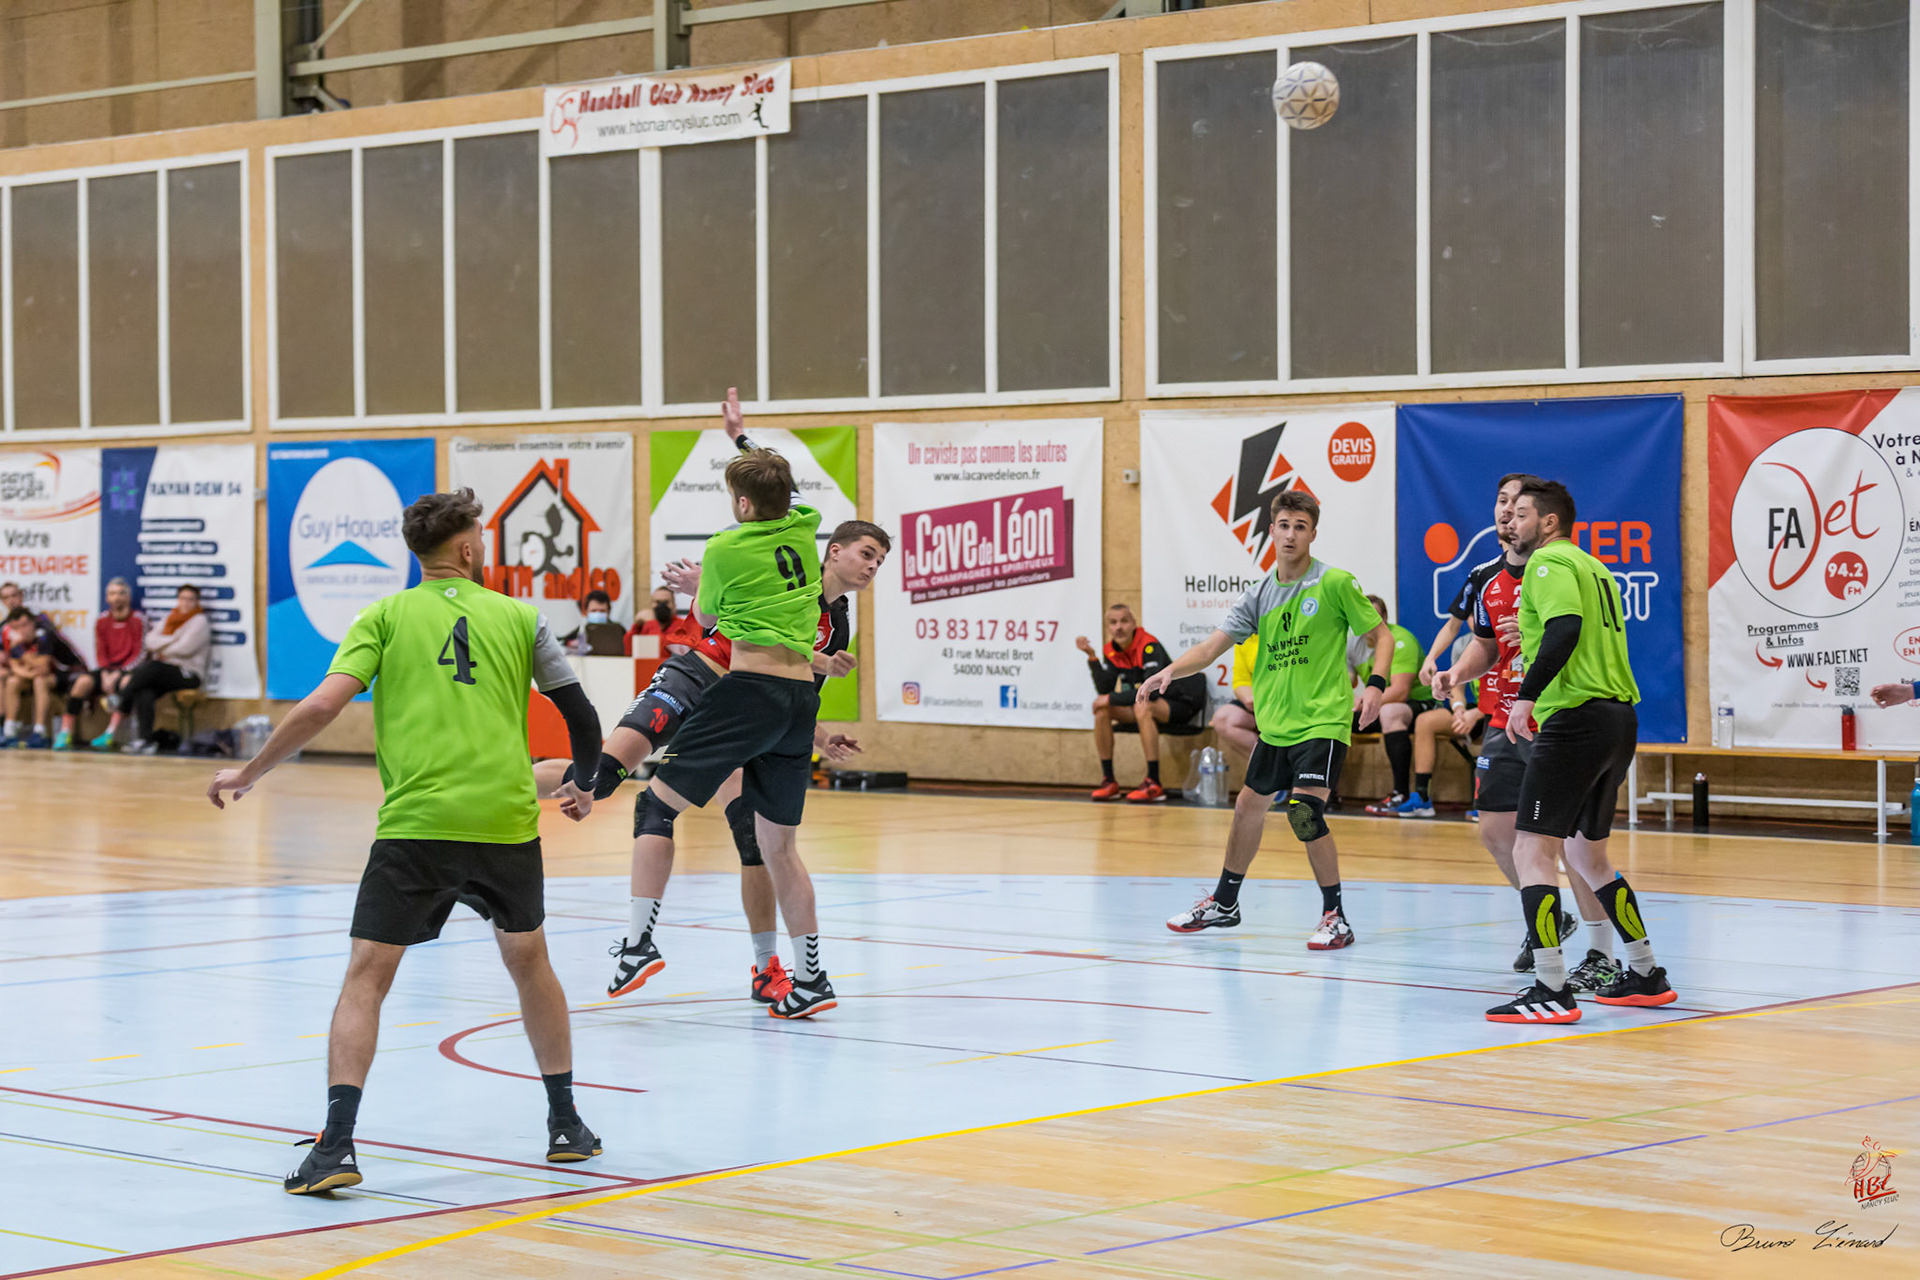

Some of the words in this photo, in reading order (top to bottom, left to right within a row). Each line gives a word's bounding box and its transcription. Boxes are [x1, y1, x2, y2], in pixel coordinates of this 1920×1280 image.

[579, 84, 641, 114] Handball
[649, 83, 682, 106] Club
[596, 111, 741, 137] www.hbcnancysluc.com
[1331, 437, 1372, 454] DEVIS
[1873, 433, 1920, 449] Votre
[908, 442, 921, 464] Un
[924, 442, 959, 464] caviste
[961, 445, 977, 466] pas
[980, 445, 1015, 463] comme
[1018, 440, 1033, 463] les
[1035, 440, 1067, 463] autres
[1331, 454, 1372, 466] GRATUIT
[1895, 450, 1906, 466] à
[933, 468, 1040, 481] www.lacavedeleon.fr
[1905, 467, 1913, 478] &
[297, 514, 332, 544] Guy
[335, 515, 399, 542] Hoquet
[905, 549, 916, 578] la
[915, 513, 978, 576] Cave
[978, 536, 993, 566] de
[993, 497, 1054, 564] Léon
[1570, 521, 1652, 564] TER
[0, 555, 89, 575] RTENAIRE
[774, 545, 807, 592] 9
[930, 570, 991, 586] CHAMPAGNES
[1001, 557, 1055, 574] SPIRITUEUX
[1827, 562, 1864, 578] 94.2
[1185, 575, 1259, 593] HelloHo
[1847, 586, 1862, 595] FM
[1186, 598, 1197, 608] La
[1201, 597, 1237, 609] soluti
[916, 618, 939, 640] 03
[946, 618, 969, 640] 83
[976, 619, 998, 641] 17
[1005, 619, 1028, 641] 84
[1035, 620, 1059, 642] 57
[1179, 622, 1221, 635] Électricit
[1282, 611, 1292, 632] 8
[1747, 621, 1819, 636] Programmes
[1766, 637, 1774, 647] &
[1777, 635, 1804, 646] Infos
[437, 616, 477, 685] 4
[941, 647, 953, 659] 43
[956, 650, 972, 659] rue
[975, 648, 1009, 660] Marcel
[1012, 648, 1034, 661] Brot
[1787, 647, 1868, 669] WWW.FAJET.NET
[953, 664, 983, 676] 54000
[986, 664, 1022, 677] NANCY
